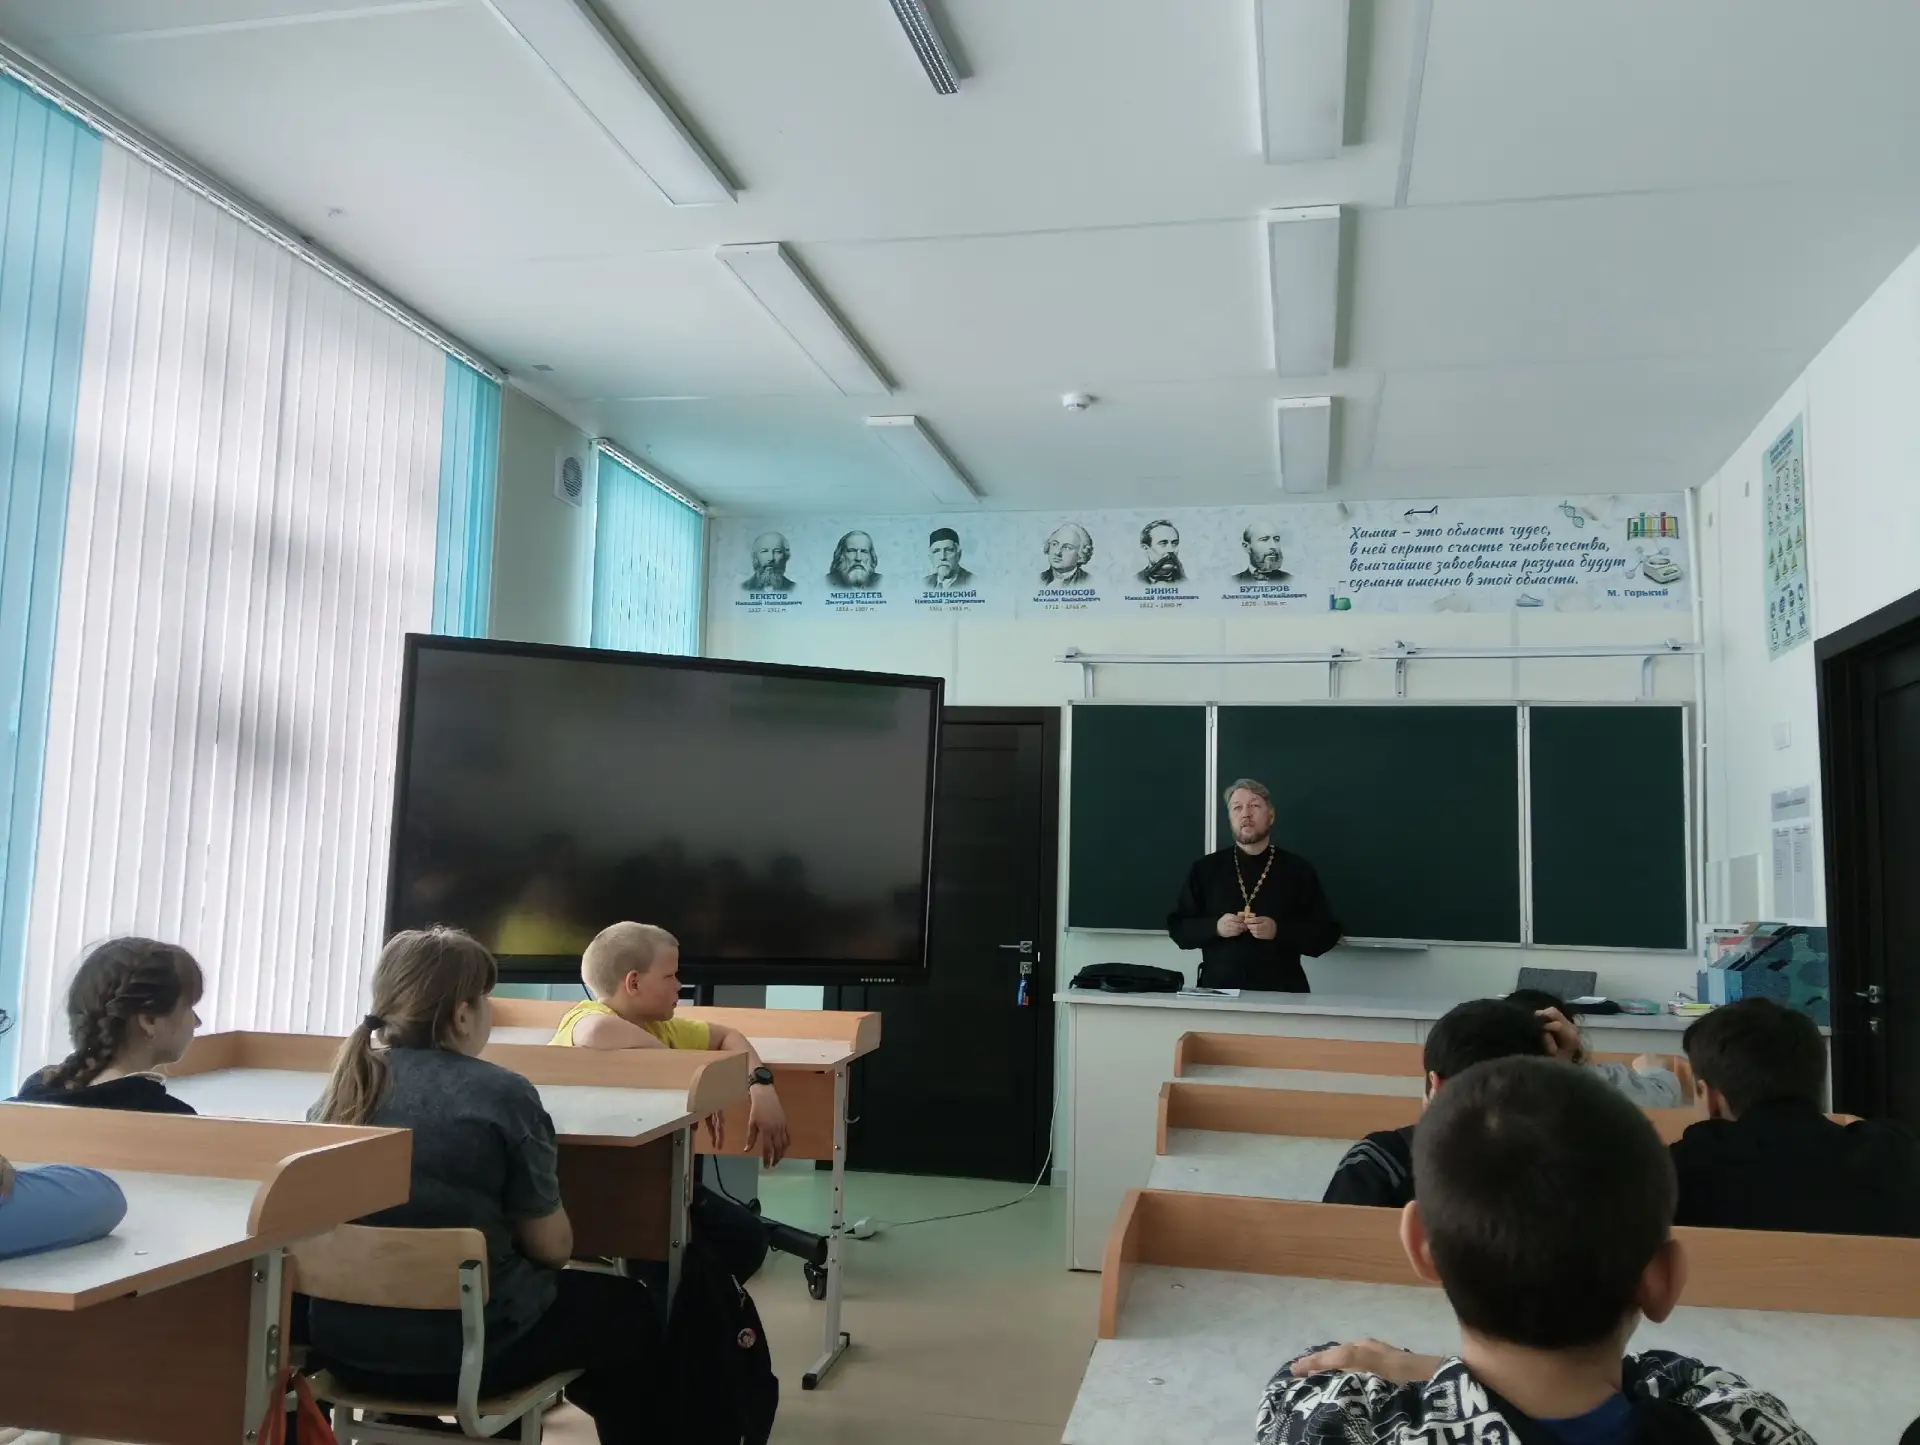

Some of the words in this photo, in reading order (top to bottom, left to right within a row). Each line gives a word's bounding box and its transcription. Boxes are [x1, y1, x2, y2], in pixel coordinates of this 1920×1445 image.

[1349, 526, 1398, 539] Химия
[1415, 527, 1443, 538] это
[1446, 522, 1505, 536] область
[1509, 525, 1551, 540] чудес,
[1349, 541, 1358, 555] в
[1361, 543, 1387, 554] ней
[1391, 543, 1443, 558] скрыто
[1447, 541, 1503, 553] счастье
[1508, 536, 1610, 552] человечества,
[1349, 557, 1433, 572] величайшие
[1433, 555, 1517, 575] завоевания
[1521, 557, 1575, 574] разума
[1579, 553, 1626, 573] будут
[1349, 576, 1403, 593] сделаны
[1406, 576, 1462, 587] именно
[1465, 571, 1474, 586] в
[1476, 572, 1511, 586] этой
[1515, 571, 1579, 586] области.
[1037, 589, 1096, 597] ЛОМОНОСОВ
[1144, 587, 1179, 595] ЗИНИН
[1239, 585, 1290, 593] БУТЛЕРОВ
[1624, 589, 1669, 598] Горький
[922, 590, 977, 598] ЗЕЛИНСКИЙ
